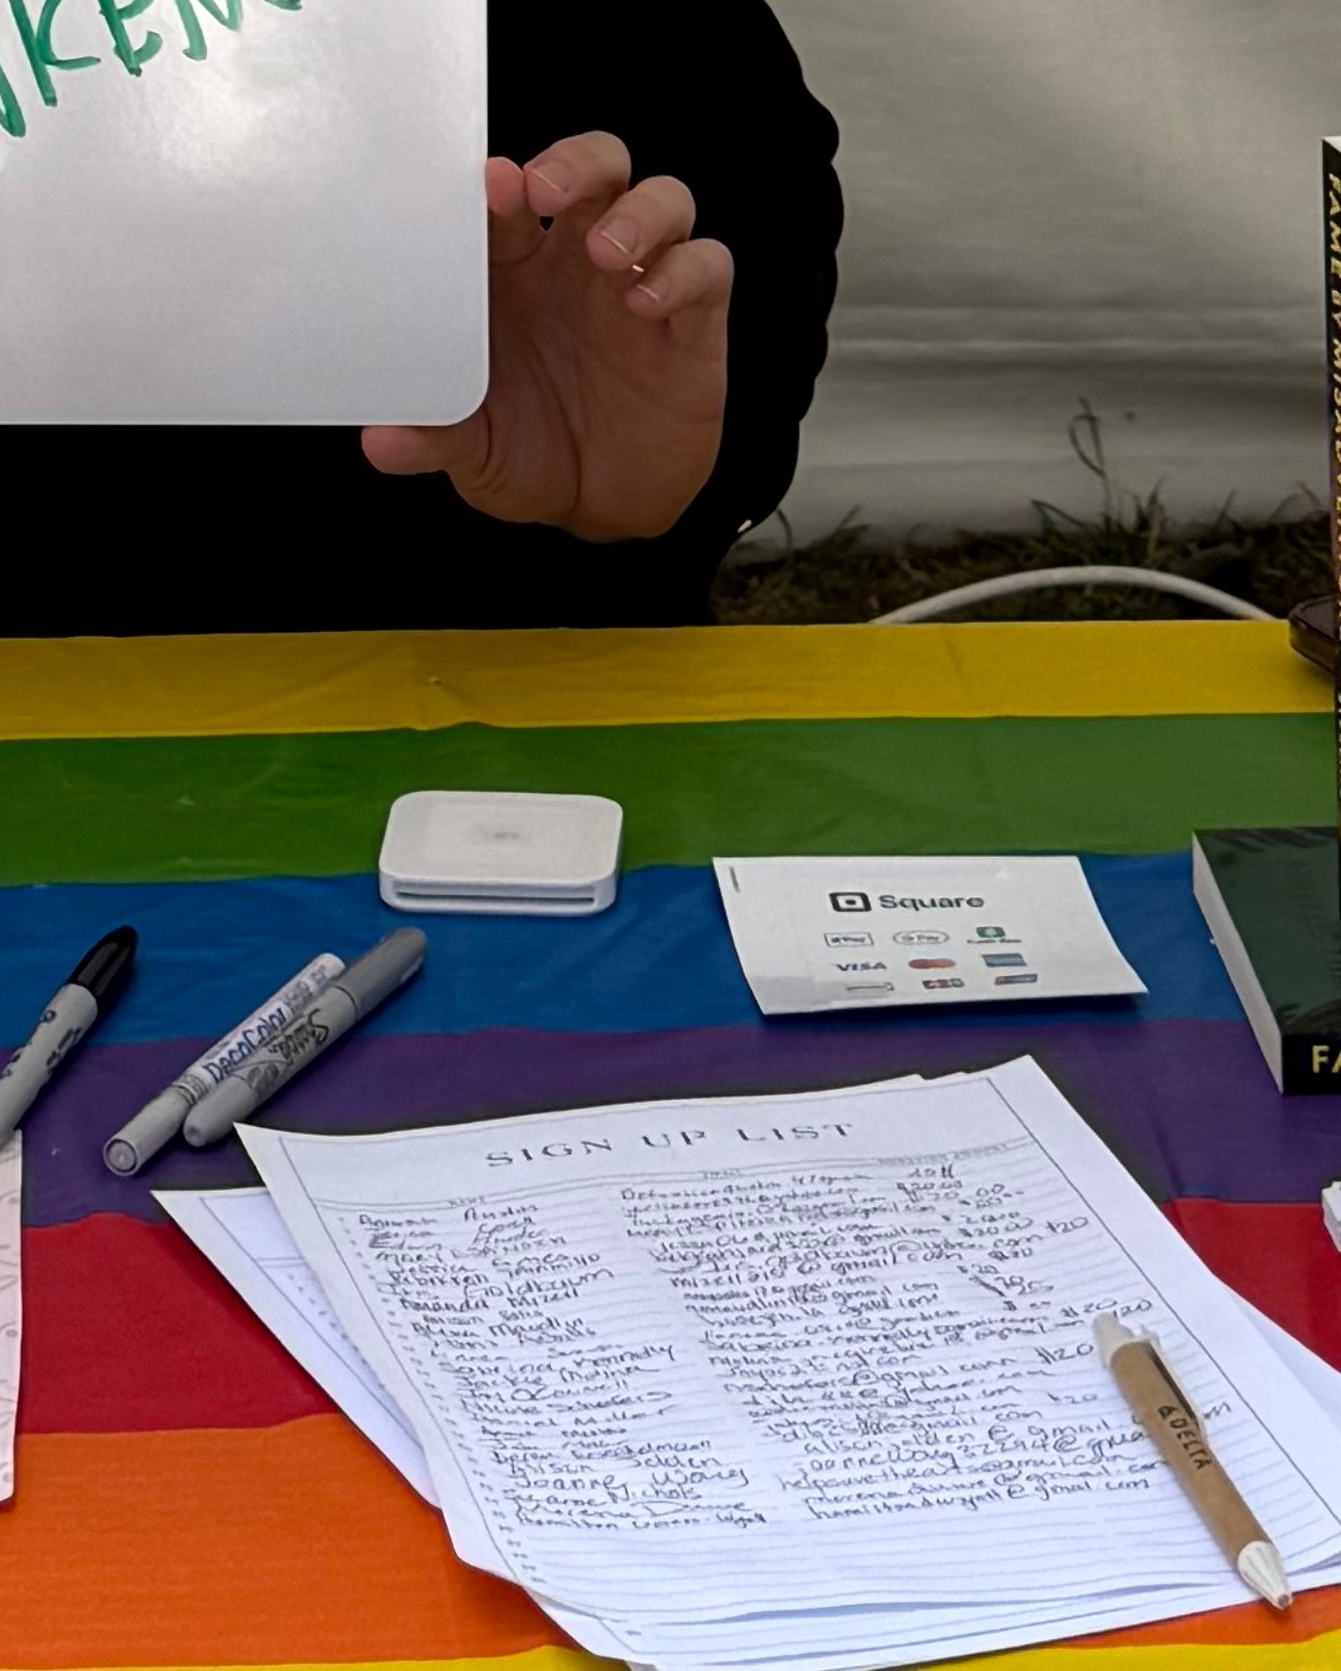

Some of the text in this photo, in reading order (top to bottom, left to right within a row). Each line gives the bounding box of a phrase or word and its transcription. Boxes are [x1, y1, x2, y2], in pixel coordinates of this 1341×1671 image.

[878, 894, 985, 912] Square
[836, 961, 888, 973] VISA
[485, 1124, 853, 1167] SIGN UP LIST
